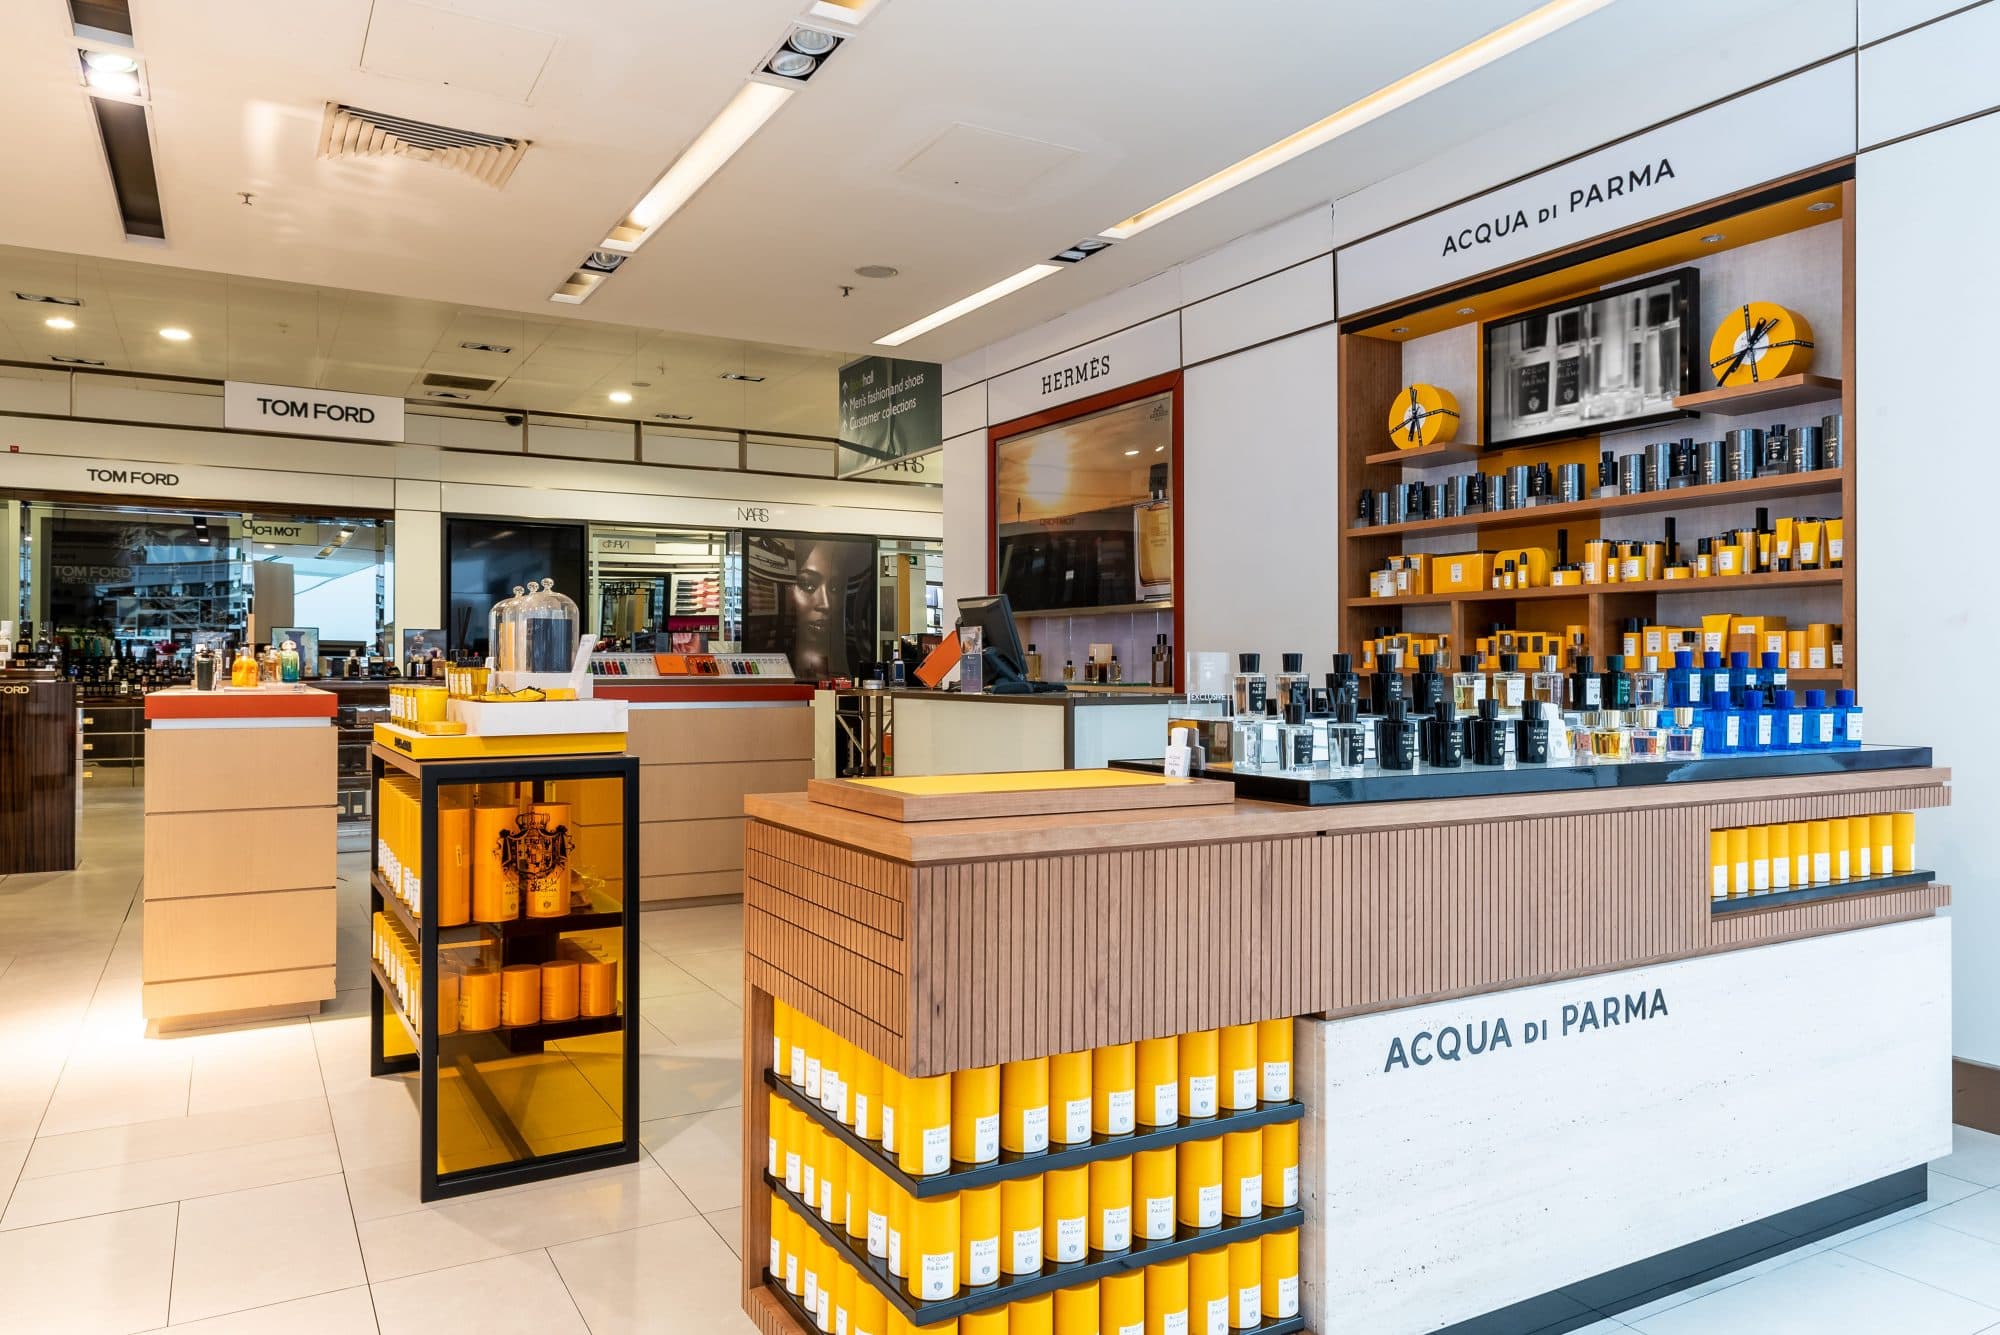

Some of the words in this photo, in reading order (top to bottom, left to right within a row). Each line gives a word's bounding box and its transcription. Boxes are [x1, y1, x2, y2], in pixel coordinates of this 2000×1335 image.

[1442, 210, 1529, 257] ACQUA
[1538, 205, 1558, 224] DI
[1570, 158, 1676, 213] PARMA
[849, 394, 867, 410] Men's
[867, 386, 891, 406] fashion
[890, 378, 904, 396] and
[904, 372, 925, 390] shoes
[1041, 355, 1111, 395] HERMÈS
[257, 397, 309, 419] TOM
[313, 403, 375, 424] FORD
[849, 410, 881, 431] Customer
[882, 397, 917, 420] collections
[86, 468, 127, 484] TOM
[130, 471, 179, 486] FORD
[737, 506, 770, 523] NARS
[52, 565, 87, 577] TOM
[89, 567, 132, 578] FORD
[1384, 1017, 1512, 1073] ACQUA
[1524, 1019, 1548, 1044] DI
[1562, 988, 1669, 1037] PARMA
